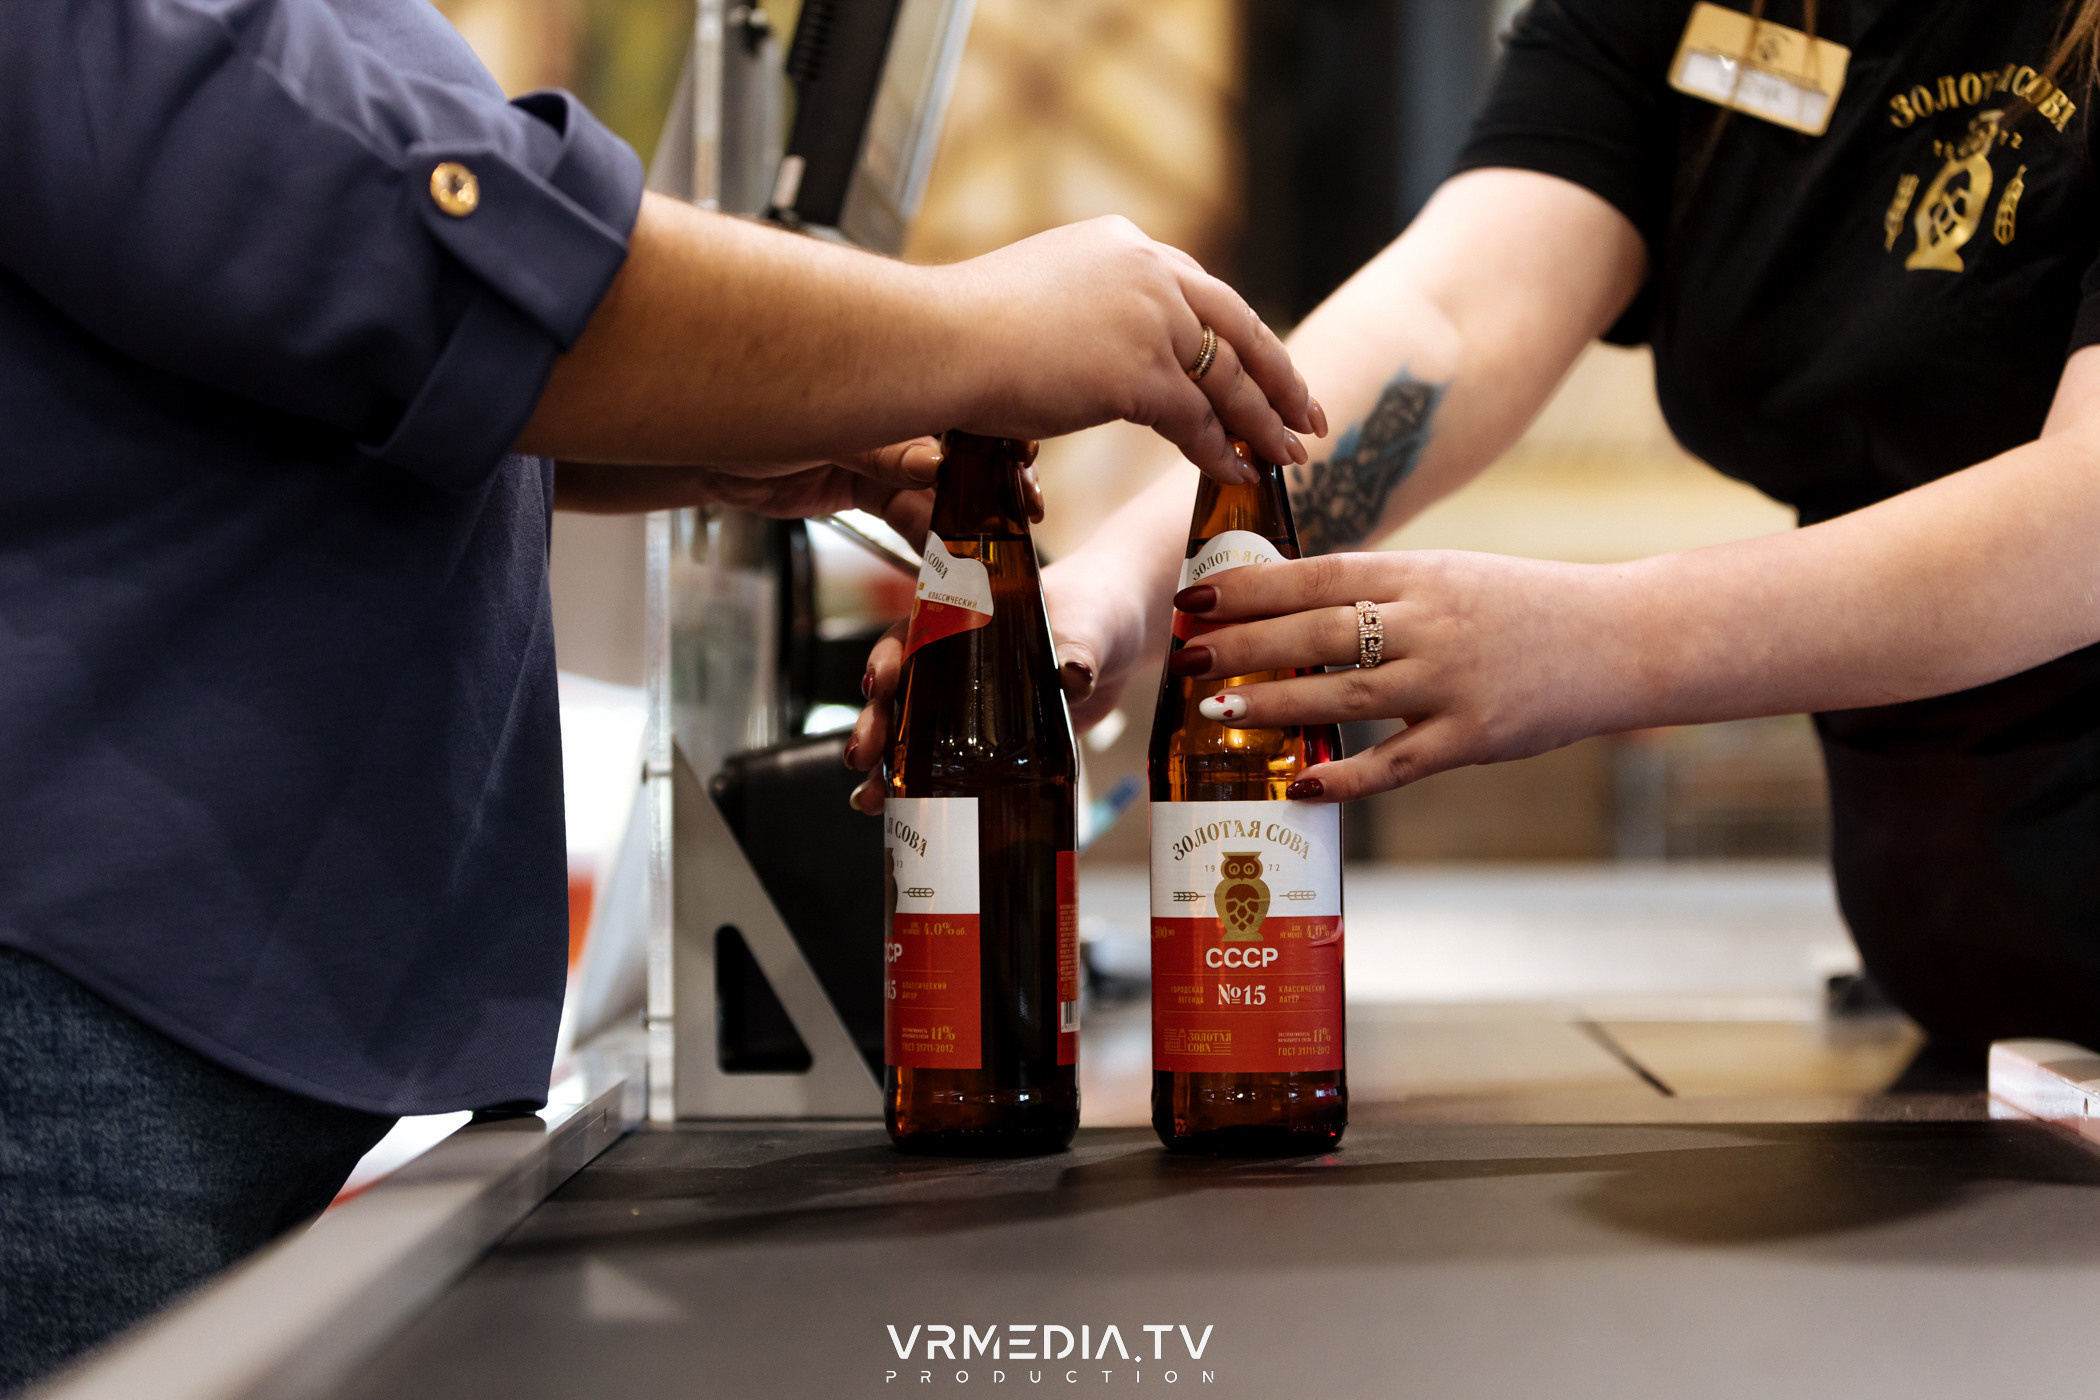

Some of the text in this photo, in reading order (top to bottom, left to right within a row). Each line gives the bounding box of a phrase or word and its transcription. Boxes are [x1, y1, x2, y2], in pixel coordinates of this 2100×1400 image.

[928, 552, 948, 580] СОВА
[928, 591, 978, 609] КЛАССИЧЕСКИЙ
[895, 821, 928, 858] СОВА
[1172, 820, 1310, 861] ЗОЛОТАЯ СОВА
[1205, 947, 1279, 968] СССР
[1170, 986, 1204, 994] ГОРОДСКАЯ
[1279, 984, 1326, 993] КЛАССИЧЕСКИЙ
[1279, 995, 1300, 1003] ЛАГЕР
[931, 1025, 956, 1041] 11%
[1188, 1032, 1232, 1042] ЗОЛОТАЯ
[1313, 1027, 1331, 1043] 11%
[1188, 1042, 1211, 1052] СОВА
[1278, 1047, 1296, 1056] ГОСТ
